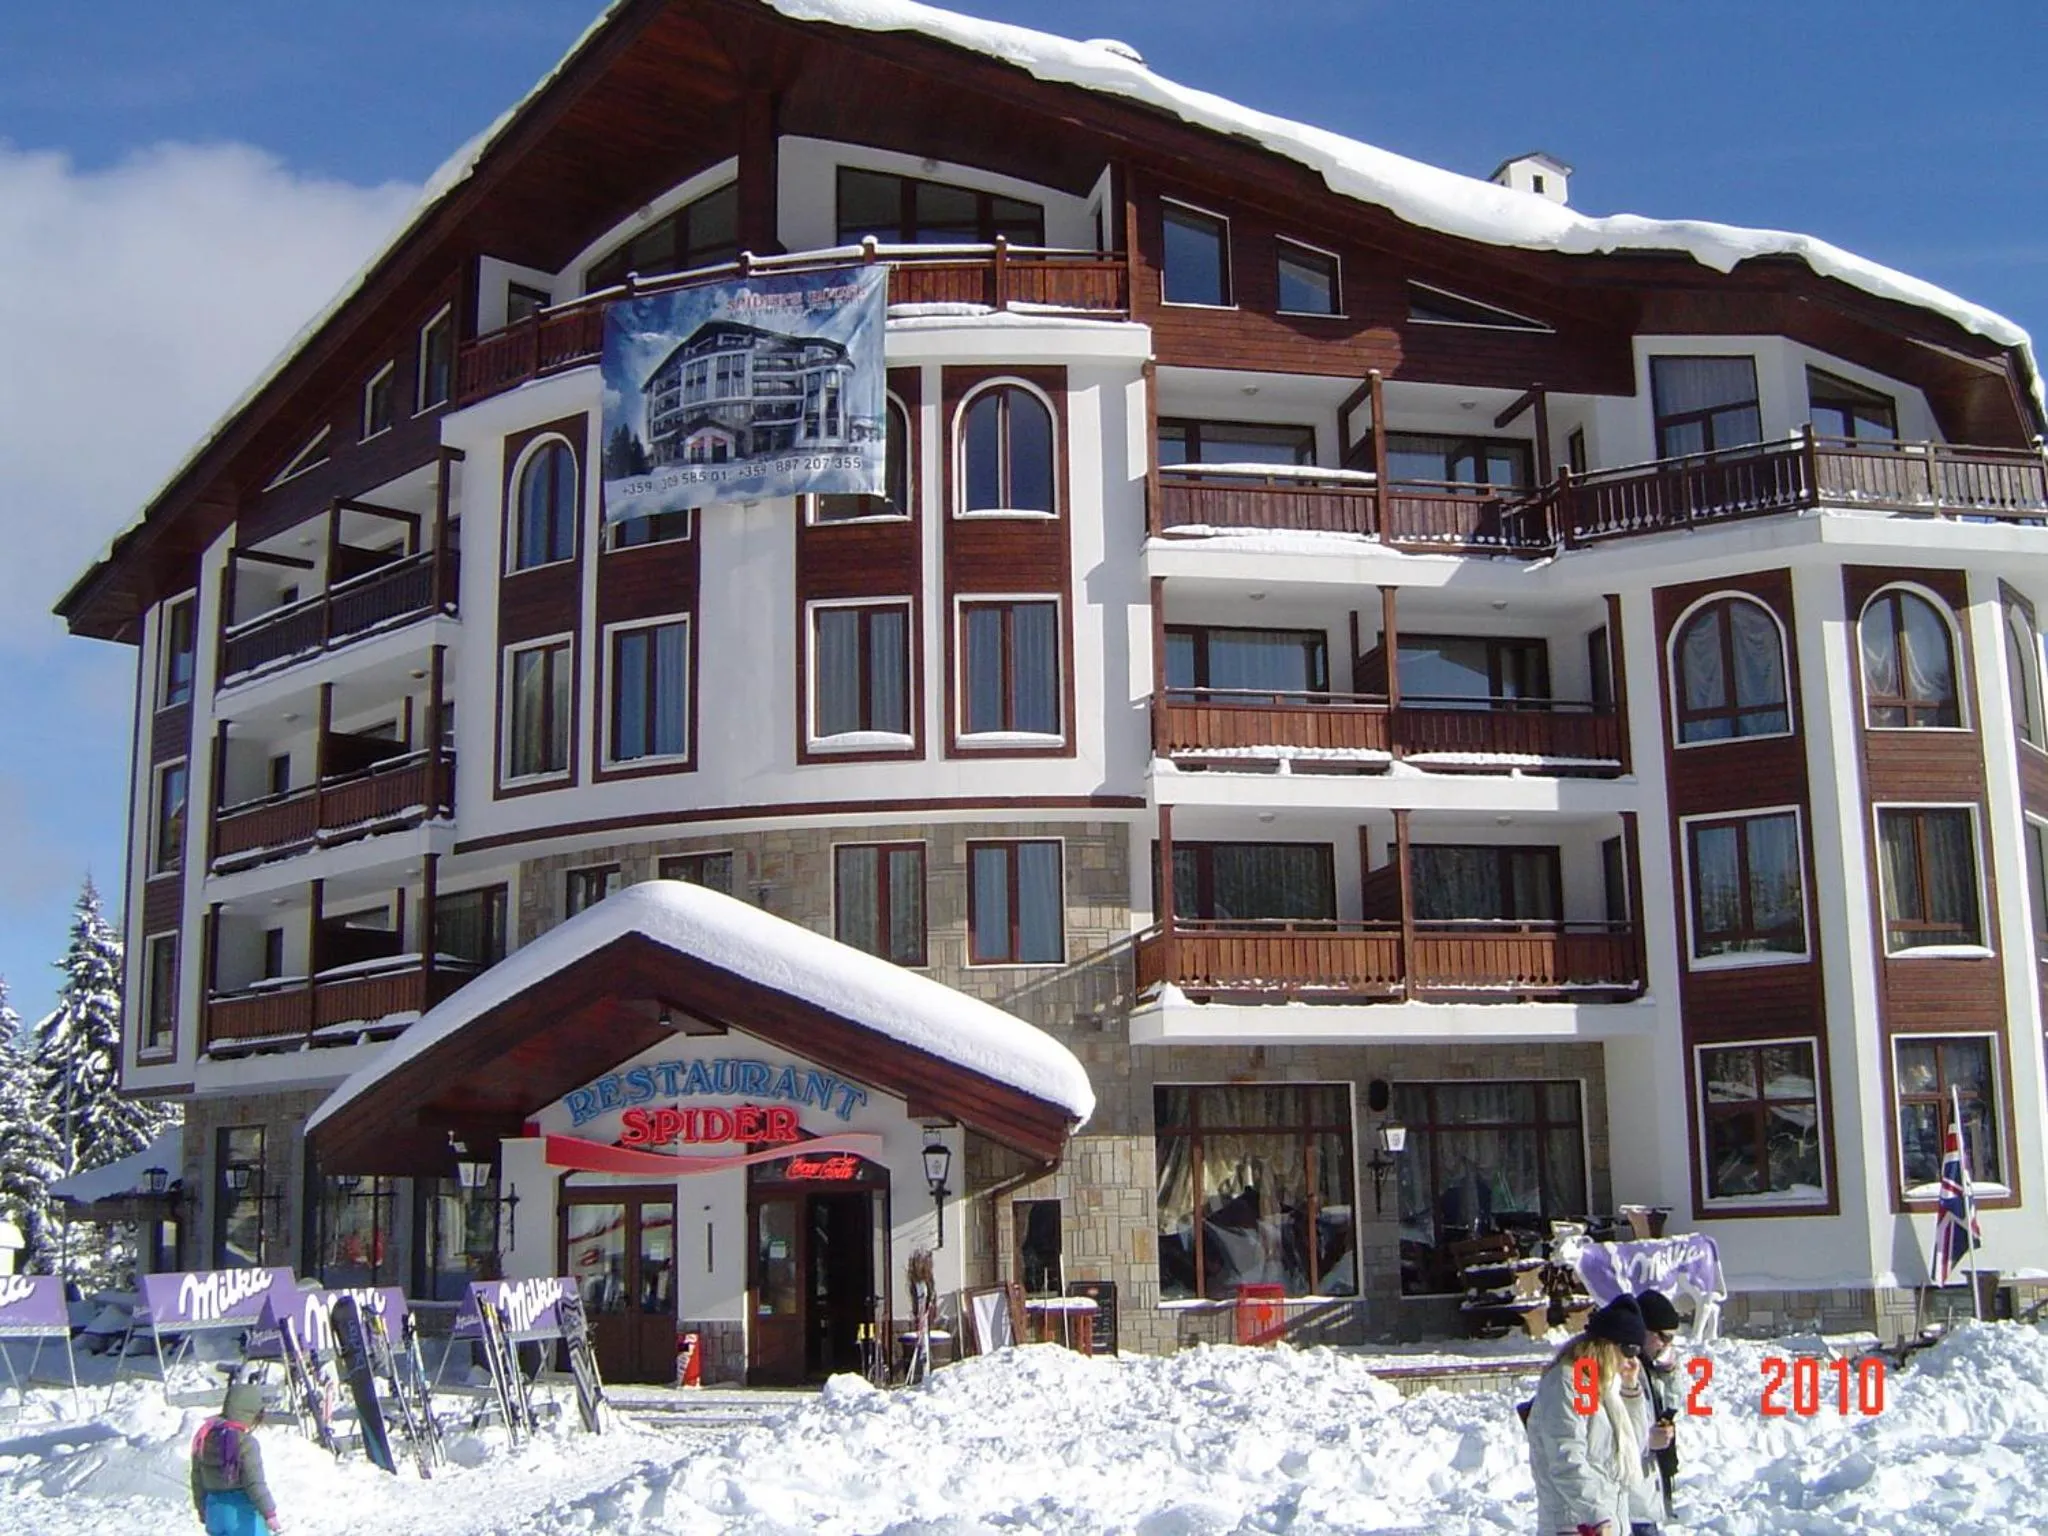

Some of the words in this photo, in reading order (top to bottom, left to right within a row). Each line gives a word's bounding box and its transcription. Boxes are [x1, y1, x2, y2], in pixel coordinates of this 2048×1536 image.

[776, 459, 798, 472] 887
[804, 457, 829, 470] 207
[834, 456, 861, 469] 355
[562, 1058, 868, 1128] RESTAURANT
[621, 1105, 800, 1146] SPIDER
[1627, 1242, 1706, 1284] Milka
[178, 1267, 273, 1321] Milka
[499, 1277, 563, 1332] Milka
